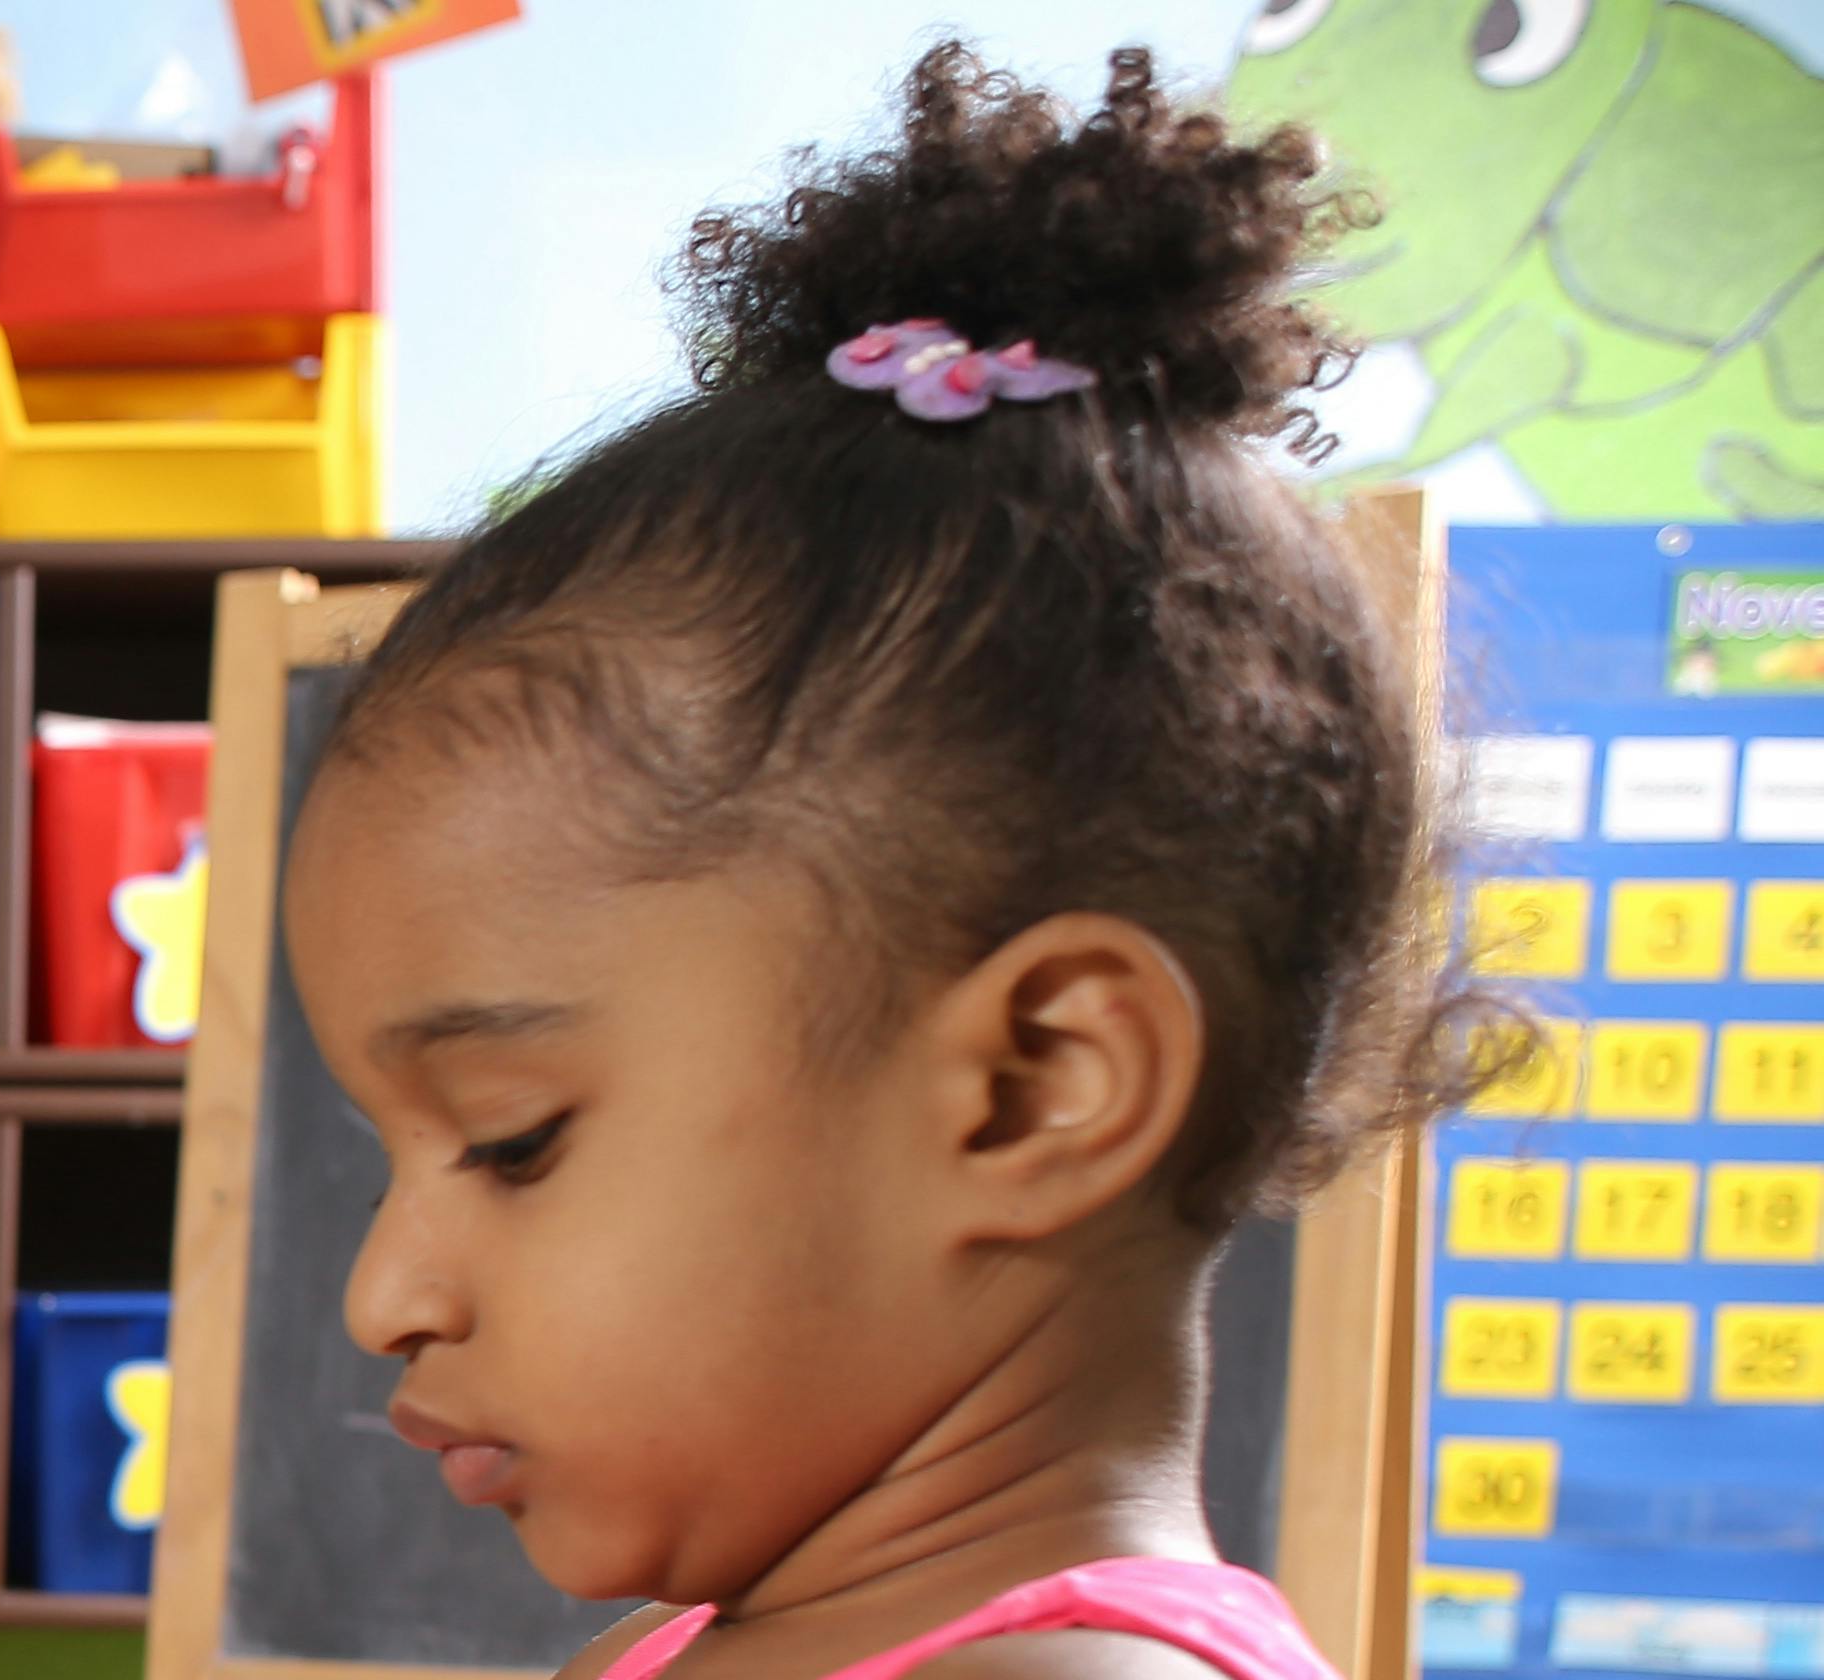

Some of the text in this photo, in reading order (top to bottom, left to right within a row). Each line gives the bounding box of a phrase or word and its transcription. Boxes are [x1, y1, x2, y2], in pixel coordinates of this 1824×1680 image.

[1647, 898, 1694, 964] 3
[1612, 1040, 1684, 1099] 10
[1749, 1043, 1811, 1101] 11
[1474, 1176, 1802, 1243] 16 17 18
[1461, 1316, 1807, 1384] 23 24 25
[1458, 1456, 1542, 1522] 30
